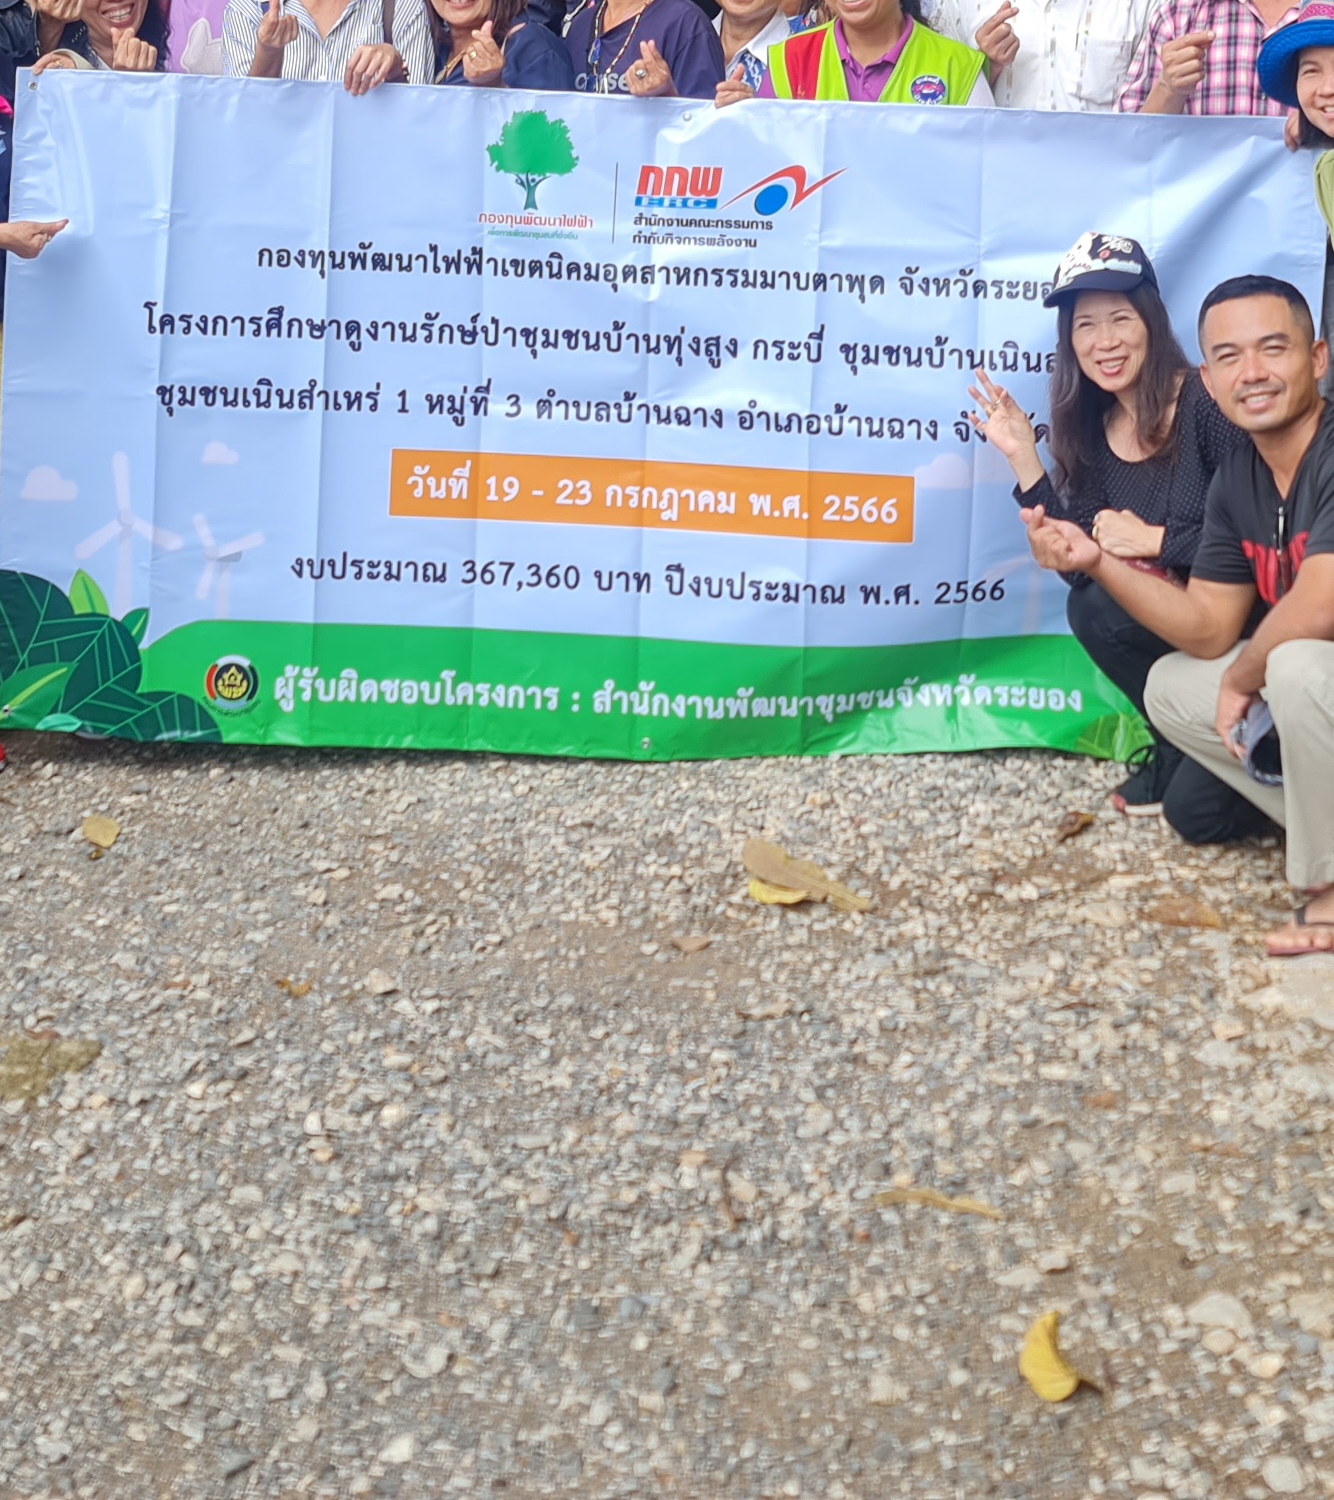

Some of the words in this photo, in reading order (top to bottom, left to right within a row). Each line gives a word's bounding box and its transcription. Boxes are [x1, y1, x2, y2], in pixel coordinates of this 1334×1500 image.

[637, 165, 723, 197] กกพ
[638, 198, 711, 208] ERC
[478, 212, 594, 229] กองทุนพัฒนาไฟฟ้า
[632, 231, 758, 249] กำกับกิจการพลังงาน
[633, 213, 774, 231] สำนักงานคณะกรรมการ
[258, 242, 886, 303] กองทุนพัฒนาไฟฟ้าเขตนิคมอุตสาหกรรมมาบตาพุด
[899, 266, 1055, 303] จังหวัดระยอ
[144, 302, 739, 369] โครงการศึกษาดูงานรักษ์ป่าชุมชนบ้านทุ่งสูง
[752, 324, 825, 364] กระบี่
[156, 378, 382, 417] ชุมชนเนินสำเหร่
[396, 389, 410, 414] 1
[425, 379, 493, 427] หมู่ที่
[505, 394, 522, 418] 3
[536, 385, 724, 430] ตำบลบ้านฉาง
[737, 399, 939, 442] อำเภอบ้านฉาง
[407, 460, 472, 500] วันที่
[485, 476, 520, 502] 19
[555, 479, 593, 506] 23
[605, 484, 737, 522] กรกฎาคม
[749, 493, 809, 520] พ.ศ.
[823, 495, 899, 524] 2566
[290, 552, 448, 584] งบประมาณ
[460, 558, 581, 592] 367,360
[594, 568, 651, 595] บาท
[665, 564, 846, 605] ปีงบประมาณ
[860, 584, 920, 606] พ.ศ.
[934, 579, 1006, 605] 2566
[274, 665, 559, 713] ผู้รับผิดชอบโครงการ
[593, 674, 1084, 723] สำนักงานพัฒนาชุมชนจังหวัดระยอง
